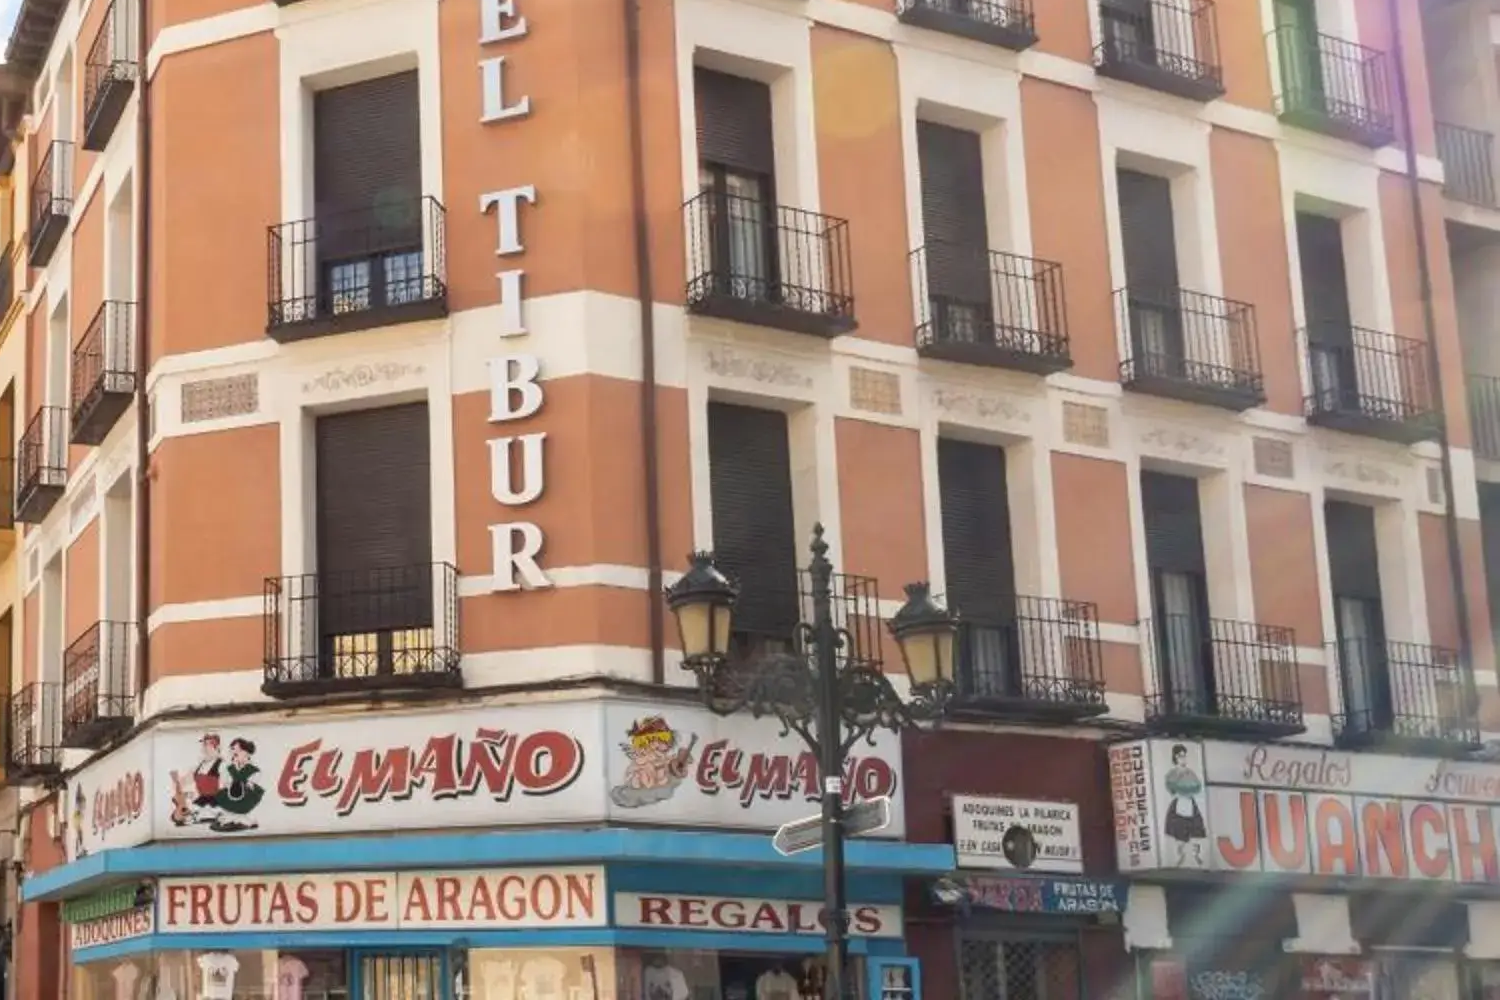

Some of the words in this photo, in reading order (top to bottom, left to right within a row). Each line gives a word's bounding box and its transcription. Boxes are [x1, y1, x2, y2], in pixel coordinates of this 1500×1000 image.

[478, 184, 554, 592] TIBUR
[1243, 745, 1352, 787] Regalos
[1019, 807, 1030, 818] LA
[166, 881, 319, 925] FRUTAS
[334, 879, 389, 923] DE
[403, 873, 596, 922] ARAGON
[1053, 881, 1097, 898] FRUTAS
[1099, 884, 1115, 898] DE
[75, 906, 151, 946] ADOQUINES
